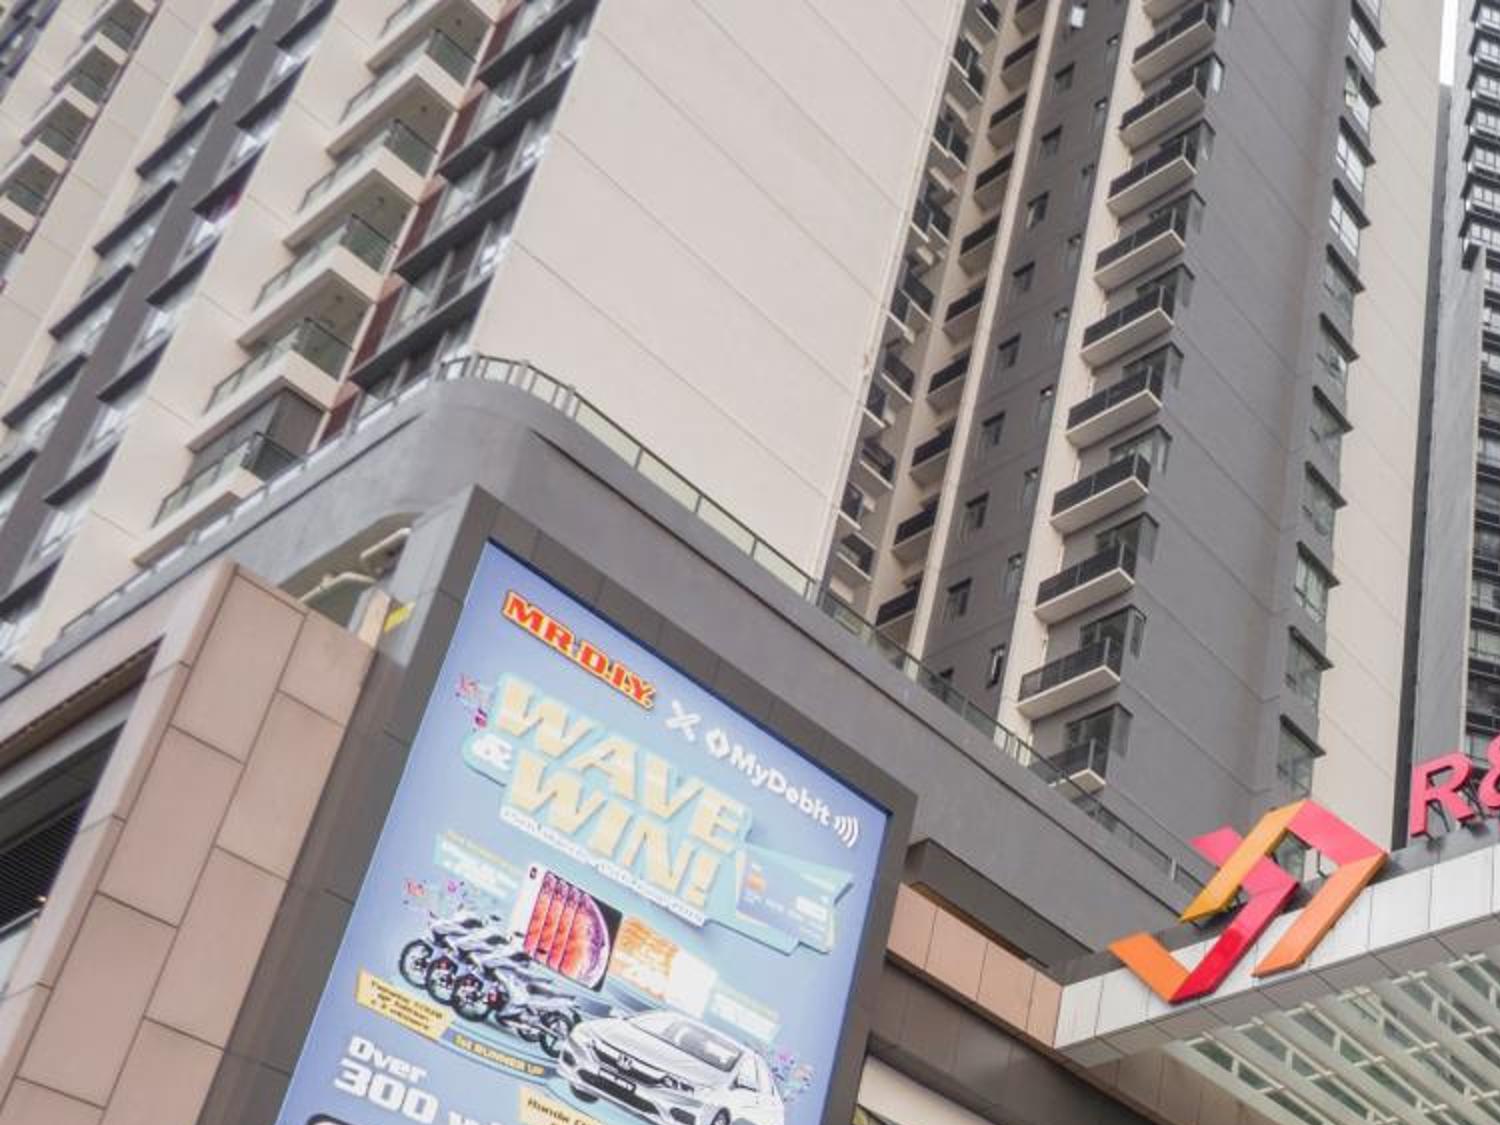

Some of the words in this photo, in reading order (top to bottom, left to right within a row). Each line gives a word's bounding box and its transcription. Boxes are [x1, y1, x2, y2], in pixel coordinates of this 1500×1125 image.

[500, 678, 746, 845] WAVE
[734, 746, 831, 827] MyDebit
[511, 750, 718, 908] WIN!
[348, 1036, 429, 1084] Over
